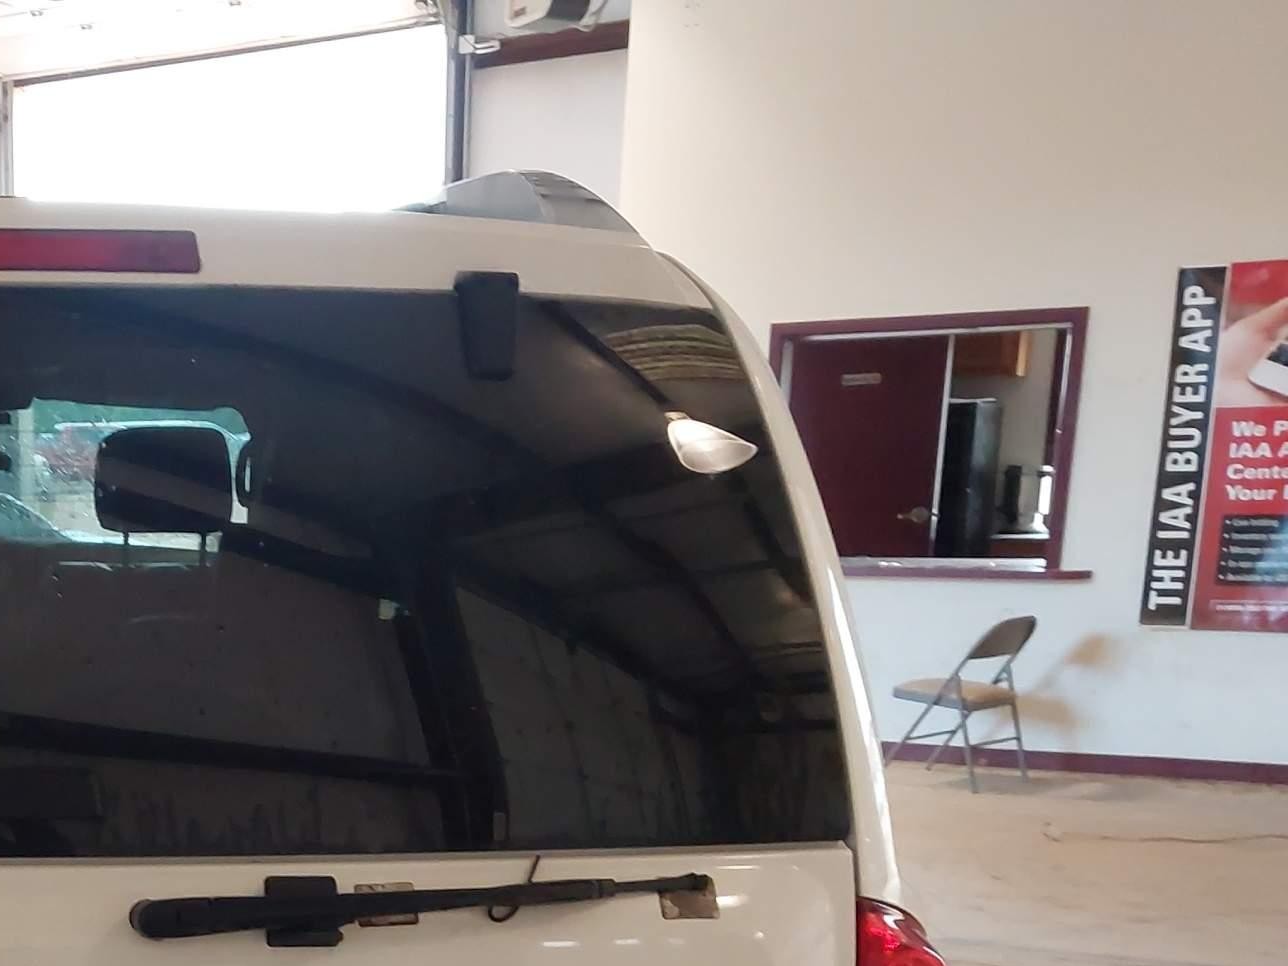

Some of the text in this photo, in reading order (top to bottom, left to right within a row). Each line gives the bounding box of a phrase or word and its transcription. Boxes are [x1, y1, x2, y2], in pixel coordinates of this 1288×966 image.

[1232, 420, 1267, 437] We
[1147, 285, 1216, 612] THE IAA BUYER APP
[1229, 442, 1273, 458] IAA
[1225, 484, 1278, 501] Your
